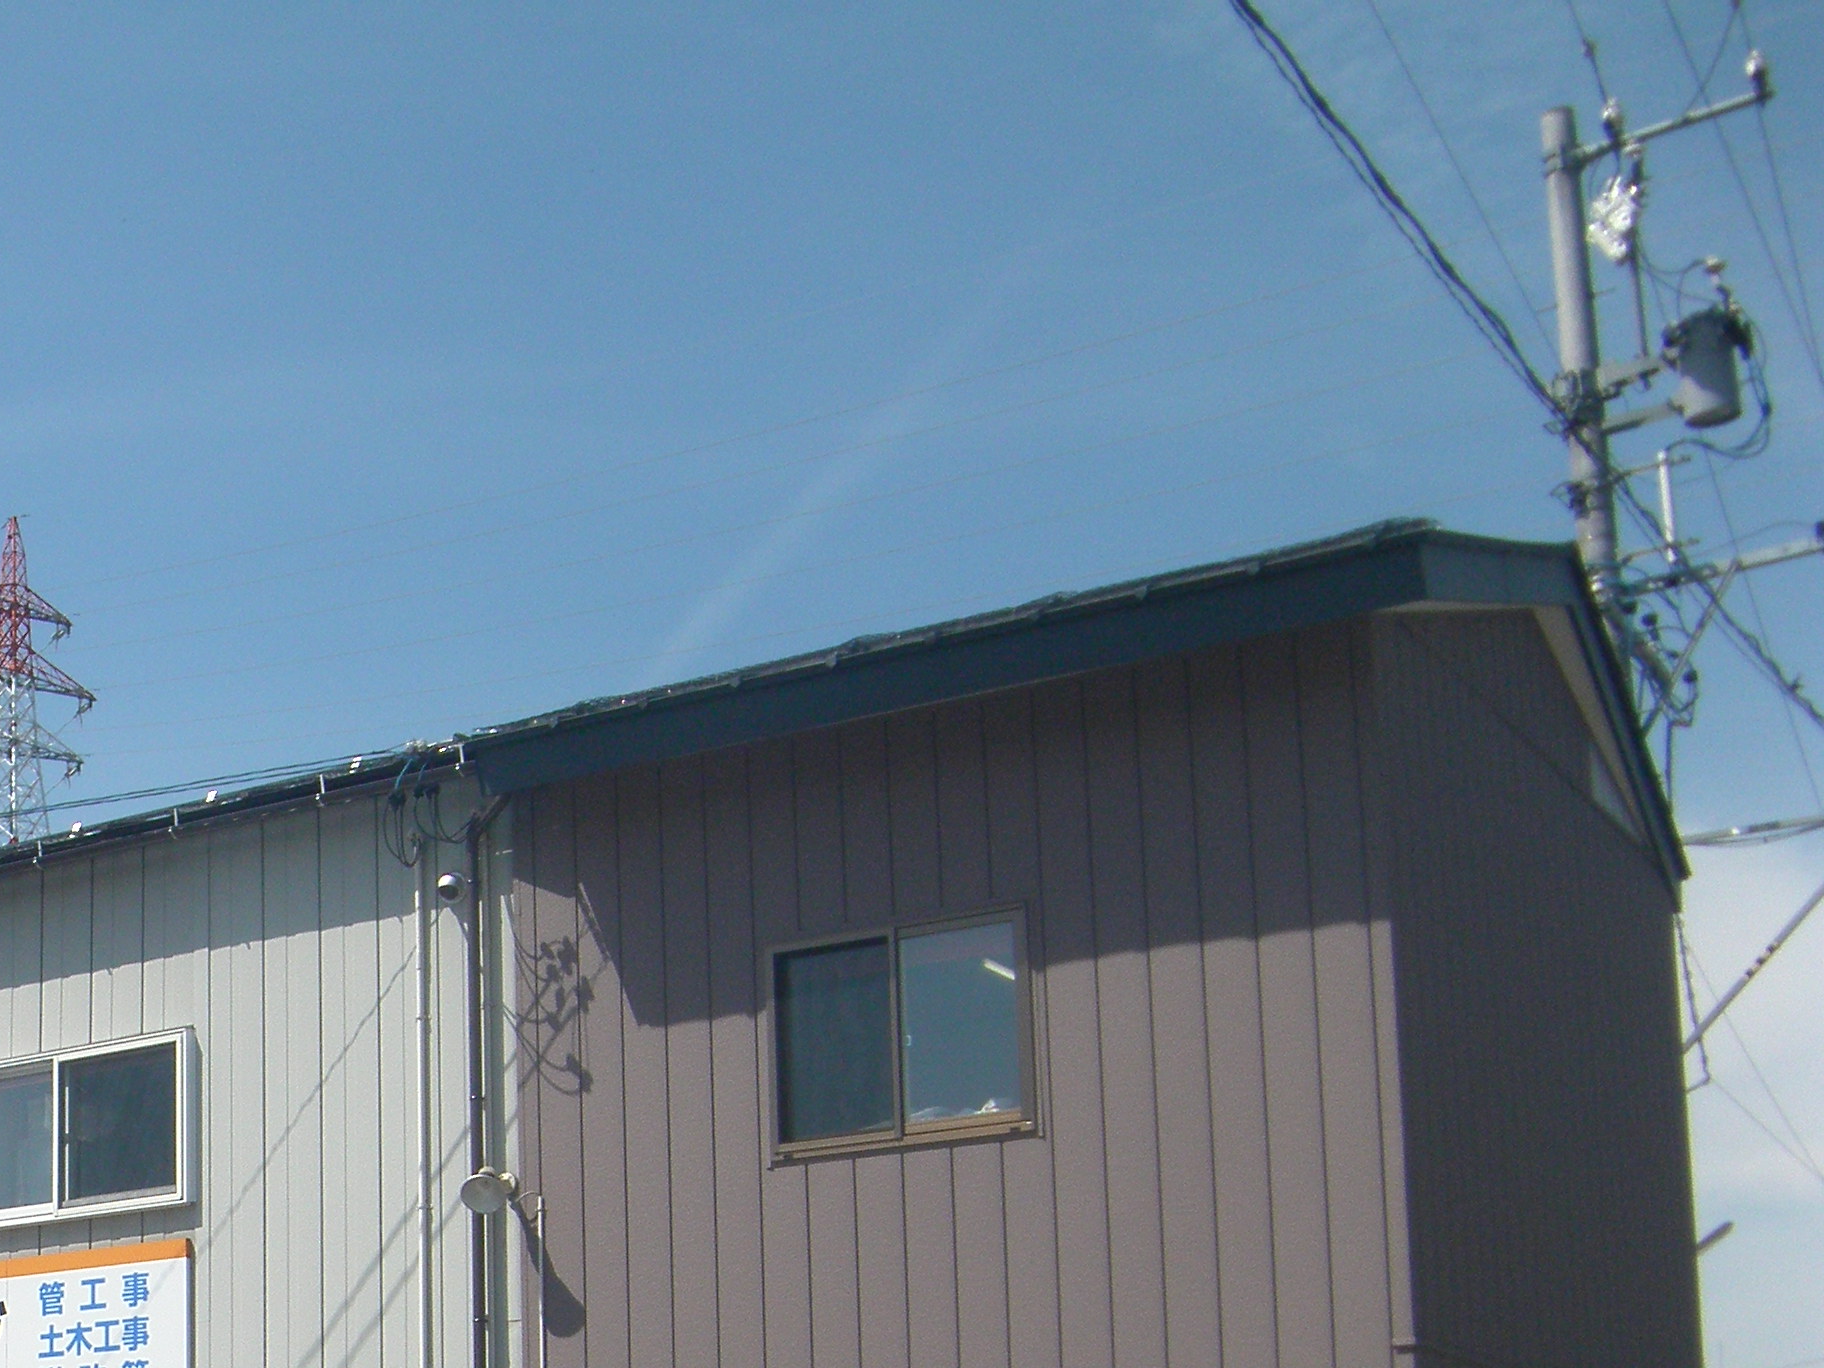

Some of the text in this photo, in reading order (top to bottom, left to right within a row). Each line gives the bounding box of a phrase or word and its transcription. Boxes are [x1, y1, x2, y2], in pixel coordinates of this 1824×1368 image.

[39, 1272, 149, 1316] 管工事
[38, 1316, 149, 1359] 土木工事
